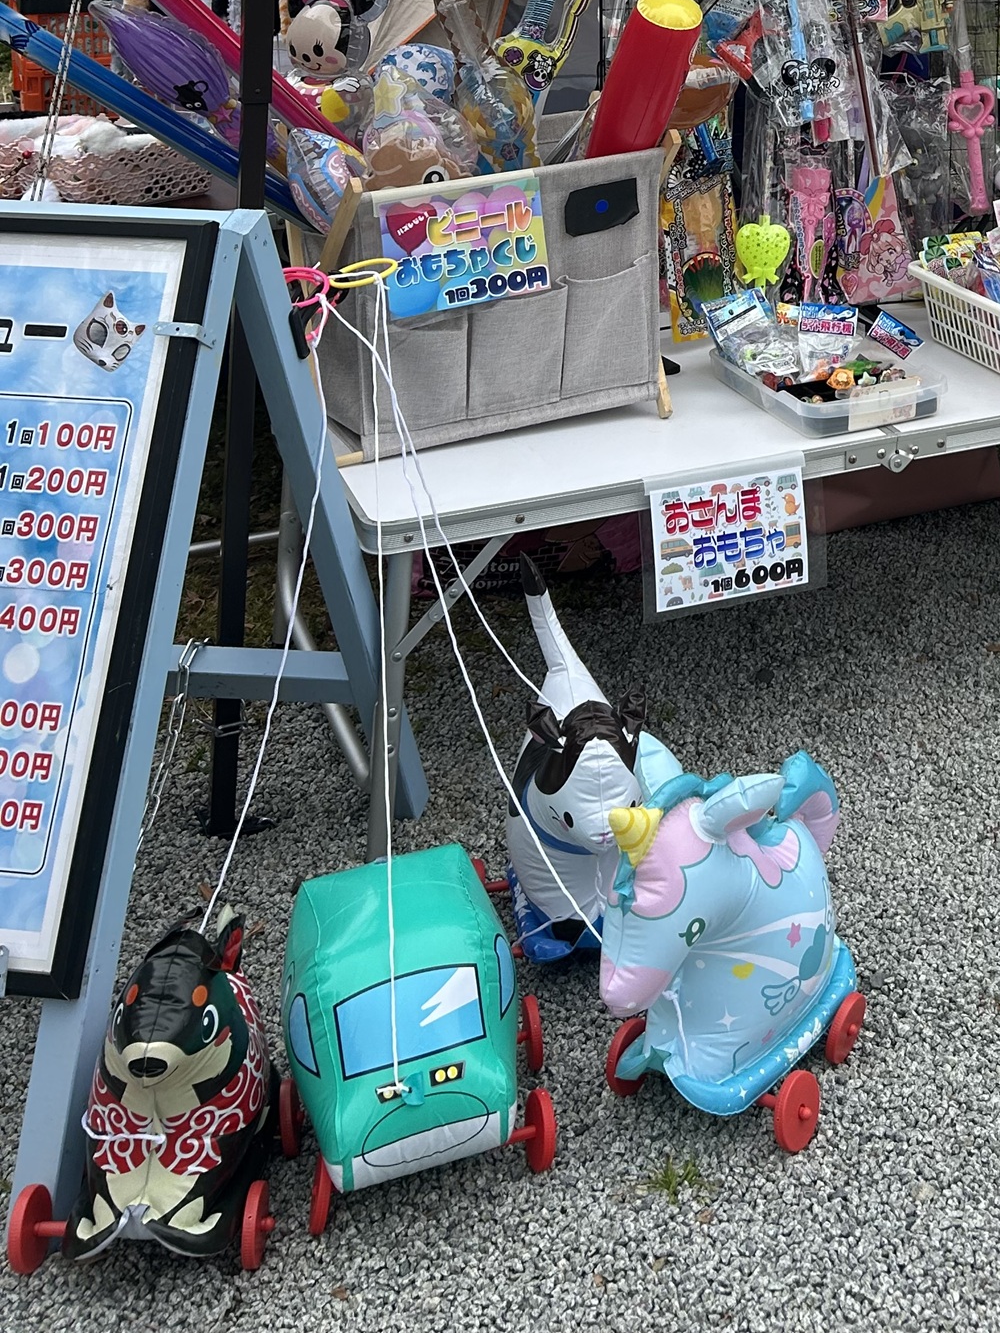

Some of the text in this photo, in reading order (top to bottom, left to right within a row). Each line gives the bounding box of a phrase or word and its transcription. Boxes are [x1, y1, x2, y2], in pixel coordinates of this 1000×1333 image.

[426, 200, 533, 248] ビニール
[394, 234, 538, 288] おもちゃくじ
[444, 264, 550, 305] 1回300円
[5, 420, 117, 451] 1回100円
[665, 485, 763, 535] おさんぽ
[693, 526, 787, 569] おもちゃ
[711, 557, 804, 593] 1個600円
